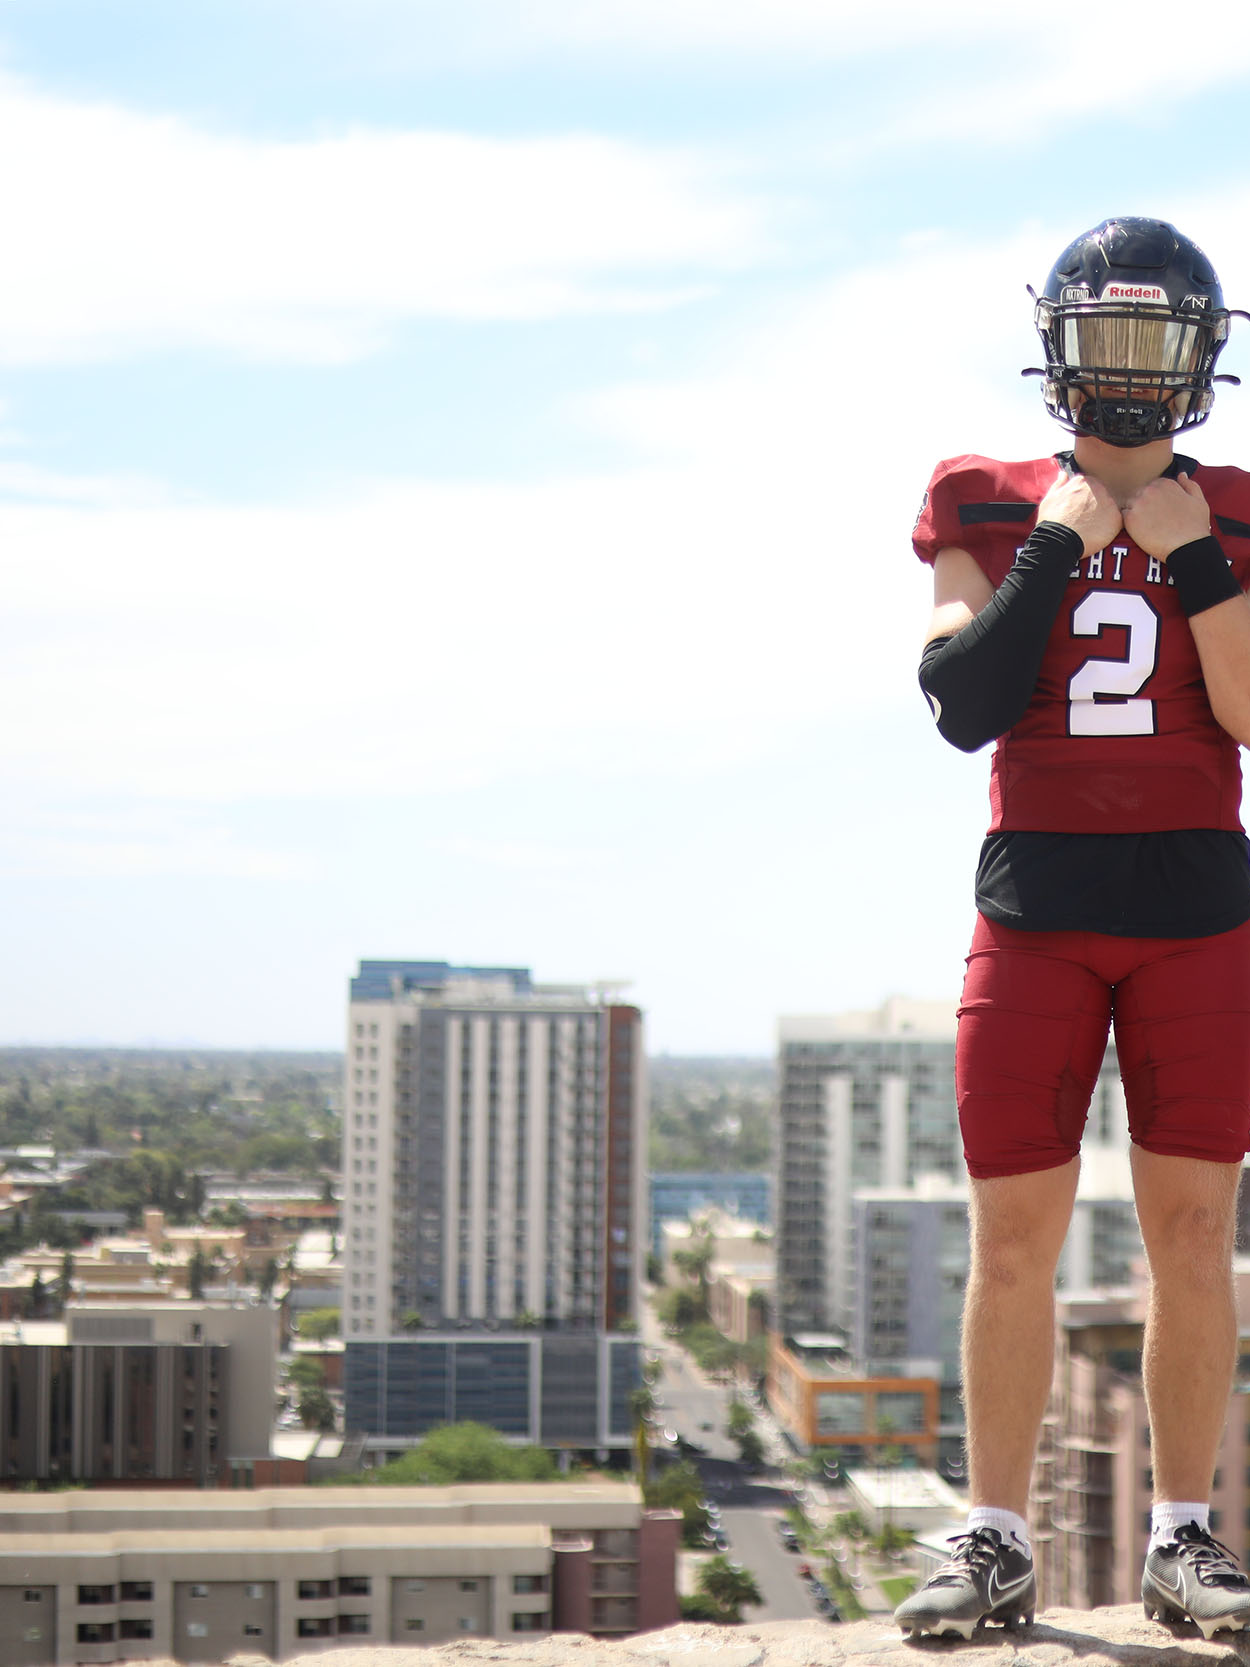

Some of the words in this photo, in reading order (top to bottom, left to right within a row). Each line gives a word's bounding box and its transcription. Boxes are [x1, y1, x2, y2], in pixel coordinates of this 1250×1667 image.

[1109, 286, 1161, 299] Riddell
[1116, 407, 1143, 415] Ridell
[1066, 588, 1161, 737] 2
